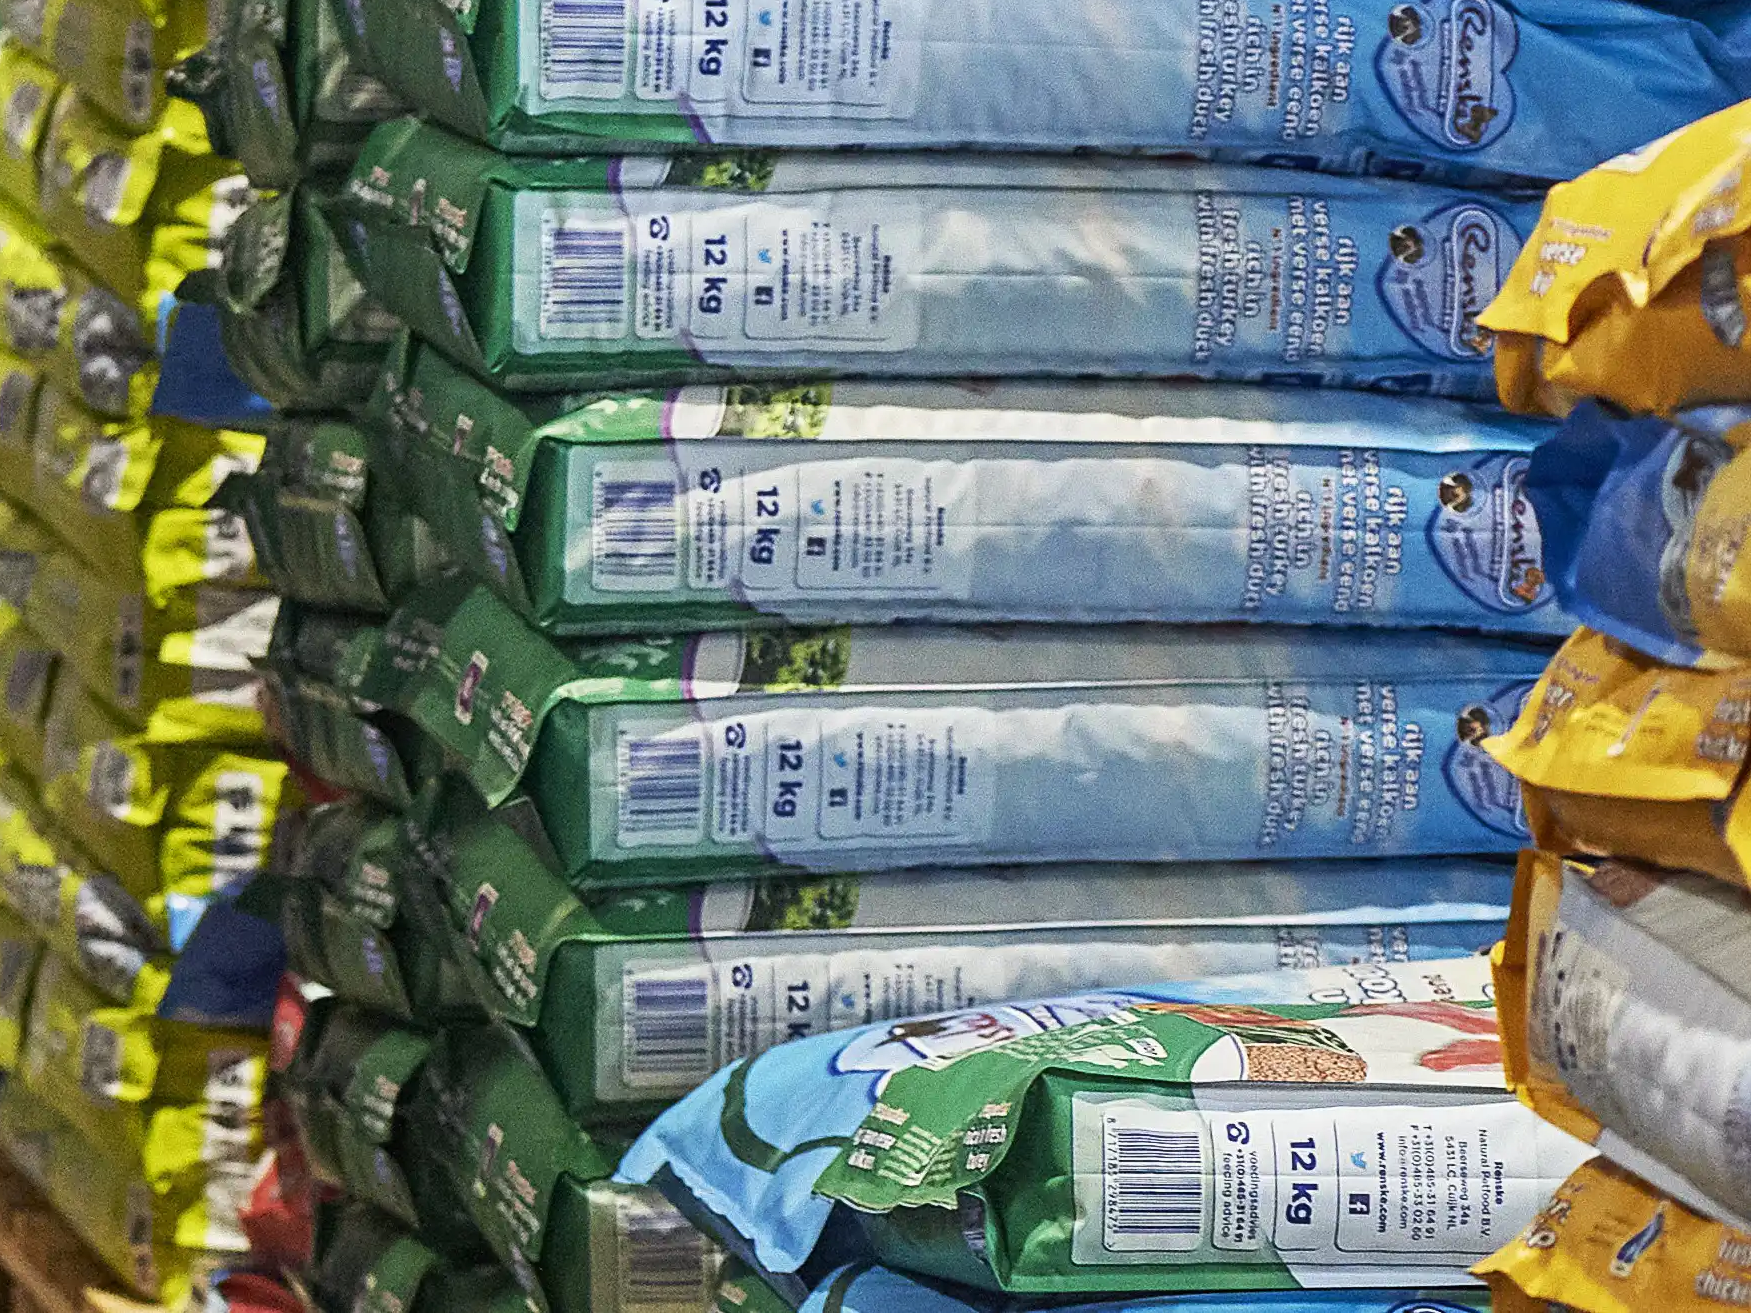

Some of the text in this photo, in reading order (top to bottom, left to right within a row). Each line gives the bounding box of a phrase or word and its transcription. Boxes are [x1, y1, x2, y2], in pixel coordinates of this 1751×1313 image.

[698, 38, 730, 78] kg
[1197, 18, 1219, 82] fresh
[1214, 47, 1239, 123] turkey
[1242, 15, 1268, 94] rich in
[1289, 18, 1308, 81] verse
[1332, 15, 1356, 102] rijk aan
[1304, 43, 1333, 137] kalkoen
[698, 233, 729, 315] 12 kg
[1215, 208, 1243, 347] fresh turkey
[1245, 241, 1266, 288] rich
[1291, 241, 1308, 305] verse
[1307, 200, 1334, 356] verse kalkoen
[1334, 236, 1357, 324] rijk aan
[749, 484, 782, 566] 12 kg
[1249, 494, 1271, 558] fresh
[1294, 490, 1317, 569] rich in
[1341, 491, 1358, 556] verse
[1358, 449, 1384, 608] verse kalkoen
[1384, 487, 1408, 574] rijk aan
[772, 739, 804, 819] 12 kg
[1401, 723, 1424, 810] rijk aan
[785, 978, 811, 1012] 12
[1285, 1137, 1319, 1226] 12 kg
[1376, 1131, 1390, 1234] www.renske.com
[1479, 1128, 1490, 1168] Natural
[1493, 1161, 1505, 1206] Renske
[1220, 1200, 1234, 1239] advice
[1247, 1150, 1261, 1241] voedingsadvies
[1413, 1208, 1425, 1224] 02
